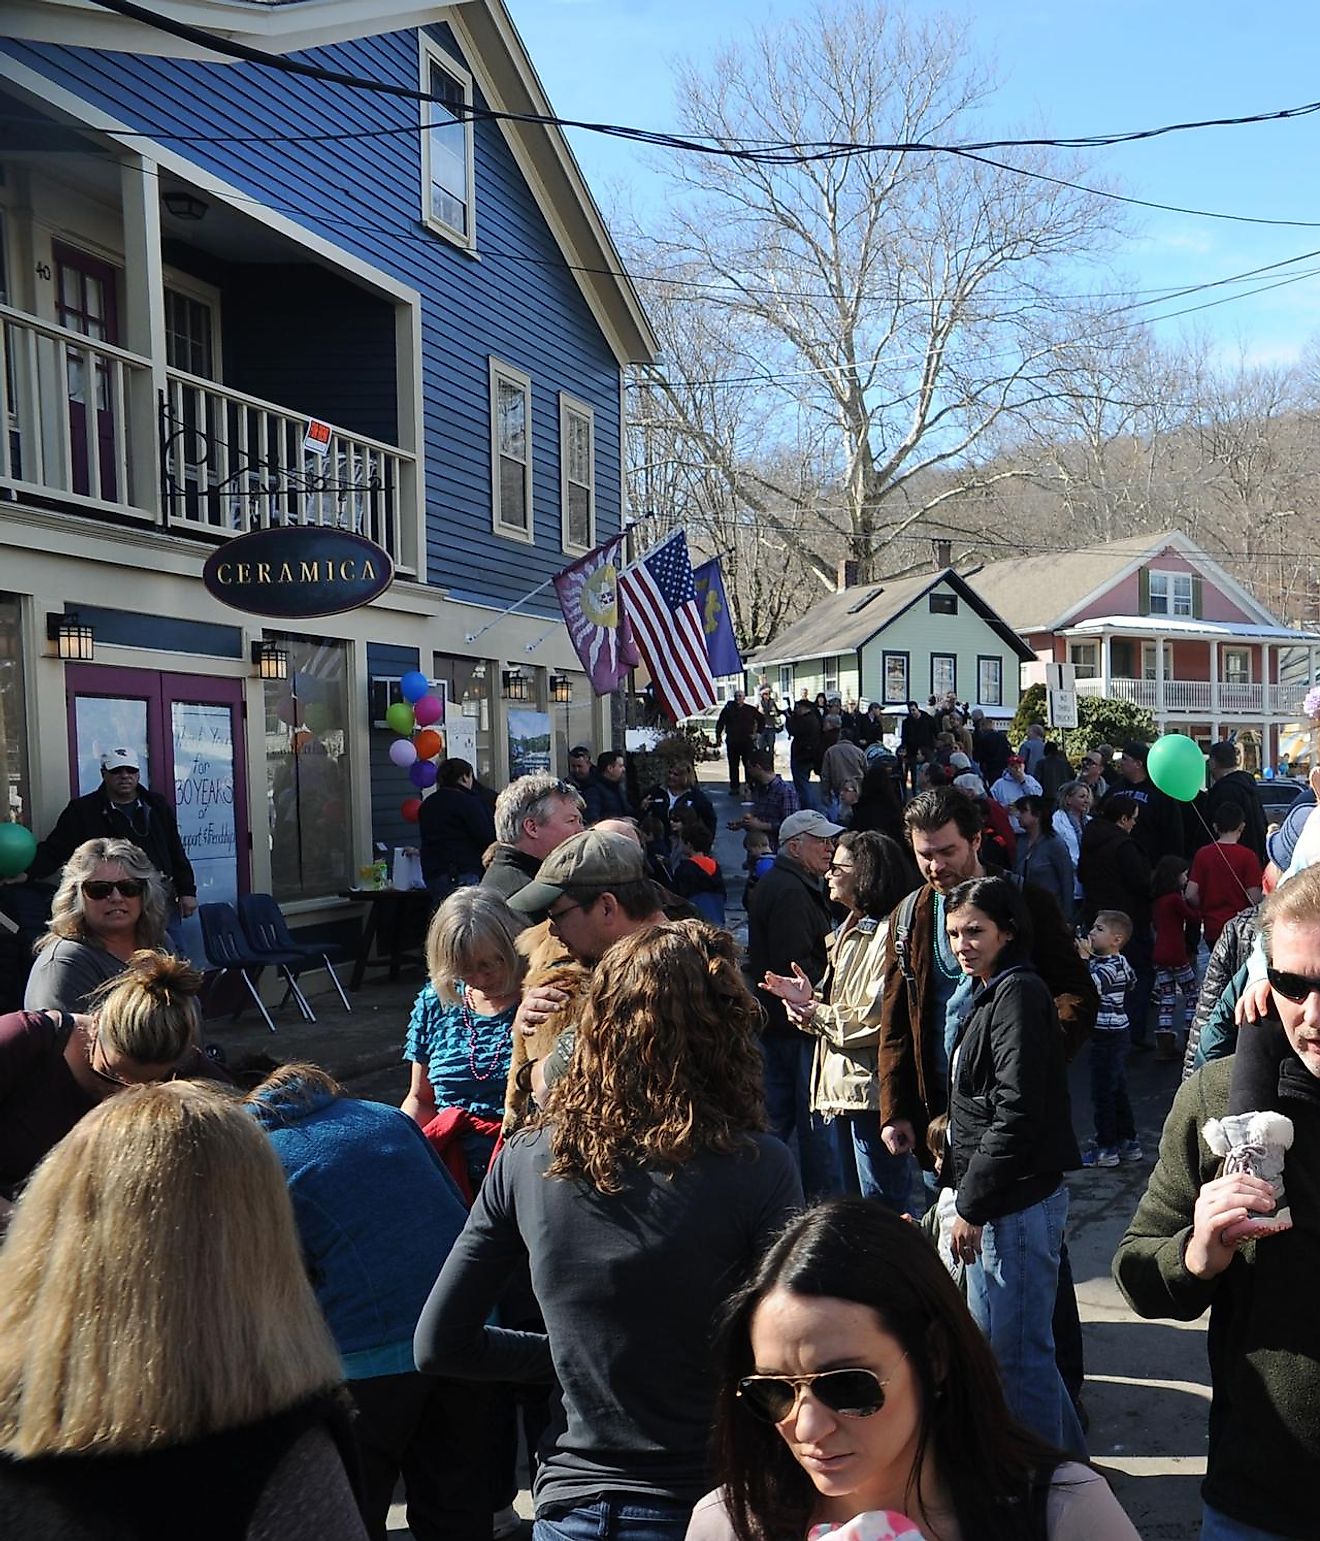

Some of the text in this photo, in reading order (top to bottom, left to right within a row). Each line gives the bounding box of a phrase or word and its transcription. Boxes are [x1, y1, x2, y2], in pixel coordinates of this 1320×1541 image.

[35, 260, 51, 280] 40
[217, 560, 376, 584] CERAMICA
[193, 752, 210, 775] for
[198, 805, 208, 819] of
